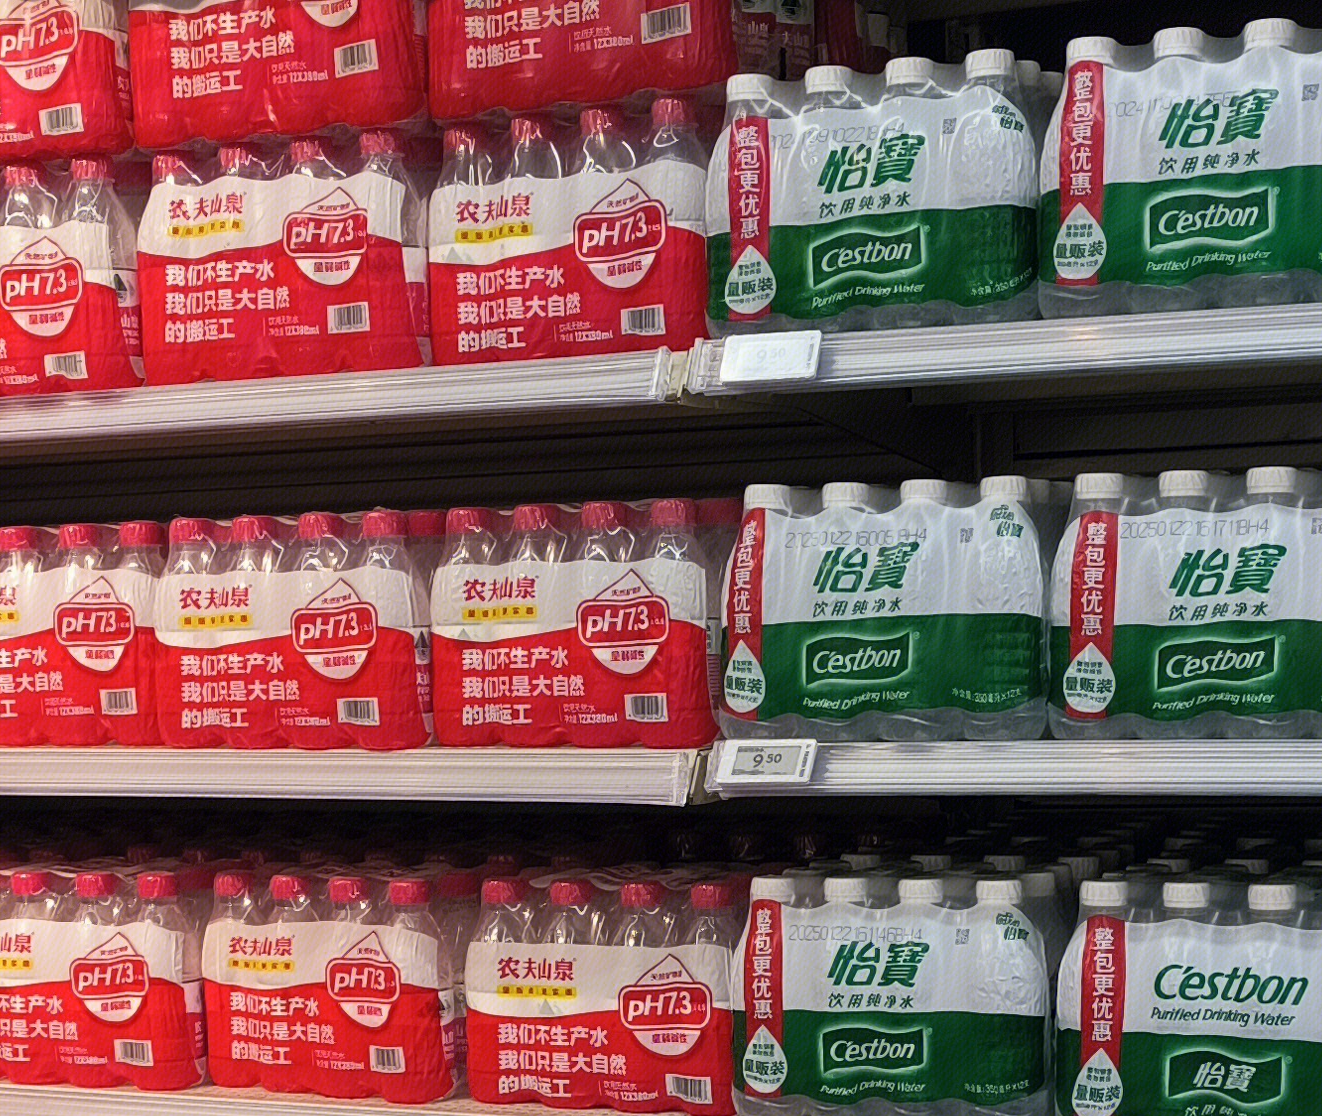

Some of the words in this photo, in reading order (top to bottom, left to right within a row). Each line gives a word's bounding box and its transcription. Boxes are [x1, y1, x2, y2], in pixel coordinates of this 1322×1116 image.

[170, 12, 276, 40] 我们不生产水
[172, 34, 294, 67] 我们只是大自然
[1159, 89, 1279, 148] 怡寶
[1071, 69, 1093, 196] 整包更优惠
[818, 134, 926, 194] 怡寶
[737, 126, 761, 237] 整包更优惠
[819, 193, 911, 218] 饮用纯净水
[291, 219, 355, 246] pH7.3
[583, 219, 648, 249] pH7.3
[165, 261, 275, 287] 我们不生产水
[456, 266, 564, 293] 我们不生产水
[166, 289, 289, 313] 我们只是大自然
[457, 295, 580, 320] 我们只是大自然
[1082, 522, 1105, 635] 整包更优惠
[1170, 545, 1287, 596] 怡寶
[587, 607, 649, 636] pH7.3
[463, 650, 567, 671] 我们不生产水
[463, 677, 585, 698] 我们只是大自然
[498, 957, 575, 981] 农夫山泉
[627, 993, 691, 1017] pH7.3
[498, 1024, 608, 1047] 我们不生产水
[498, 1050, 627, 1075] 我们只是大自然
